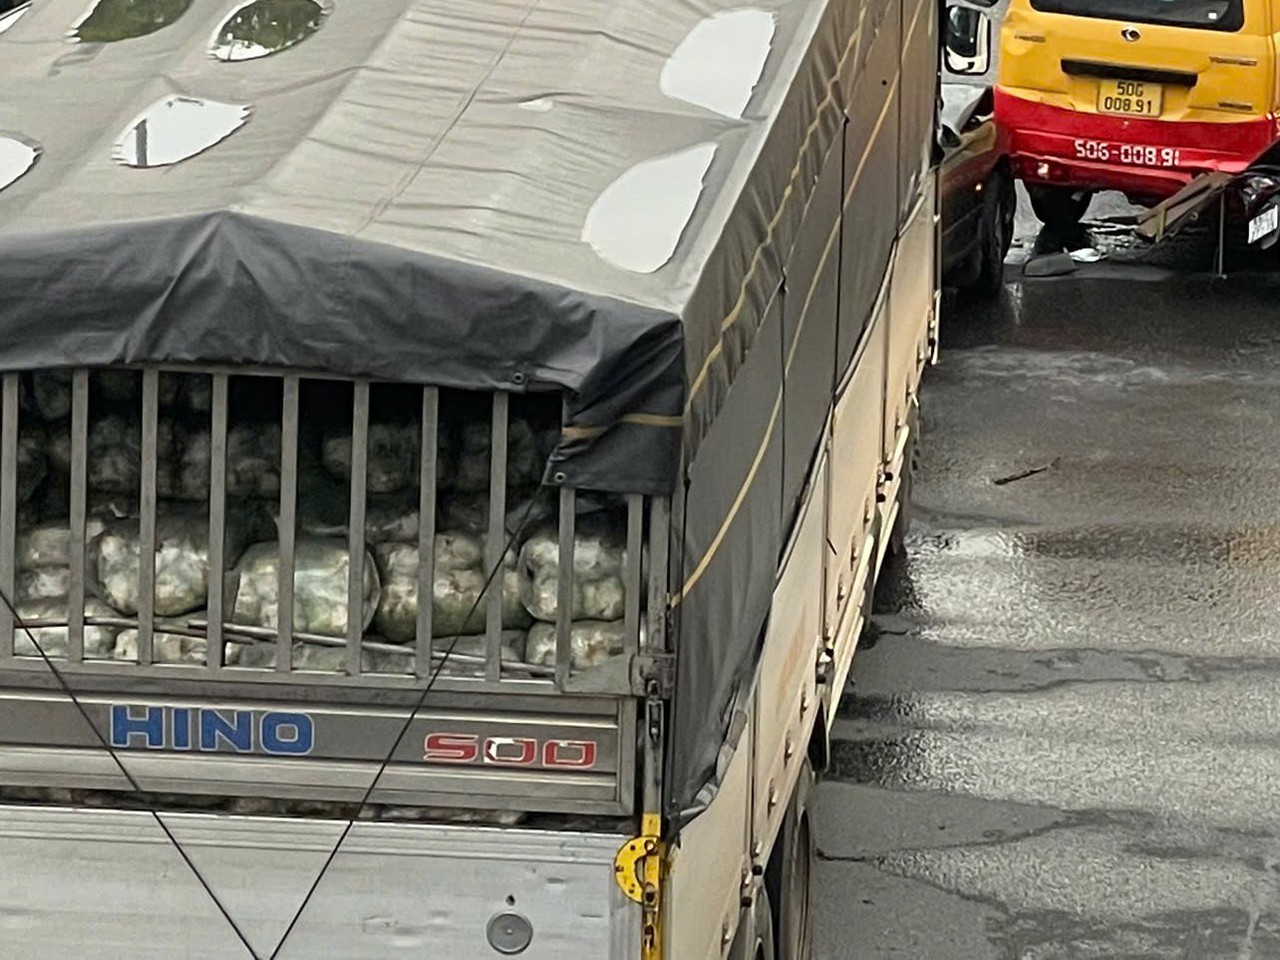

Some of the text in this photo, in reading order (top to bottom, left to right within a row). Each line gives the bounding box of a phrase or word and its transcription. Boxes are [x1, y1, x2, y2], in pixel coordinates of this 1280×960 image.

[1117, 81, 1144, 96] 50G
[110, 705, 315, 755] HINO
[424, 733, 597, 768] 500
